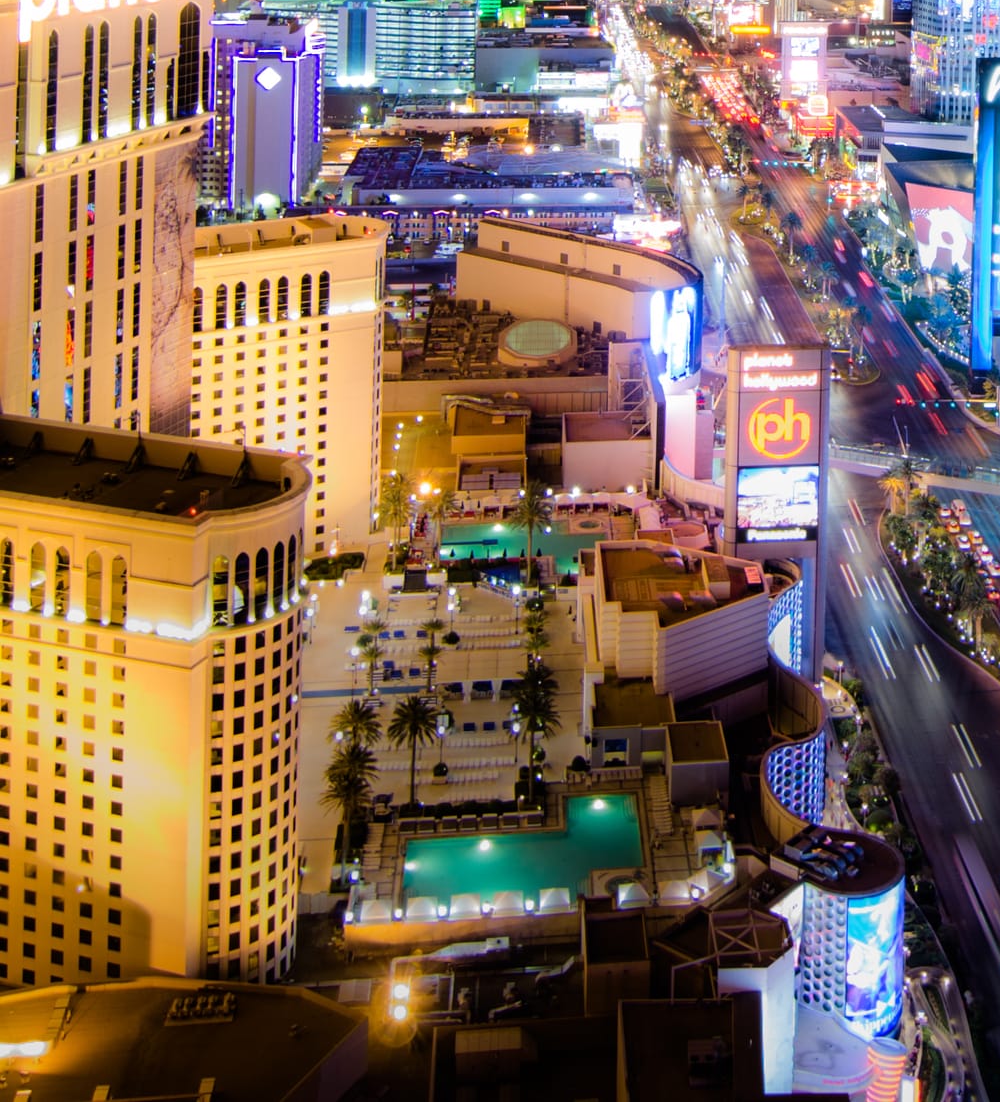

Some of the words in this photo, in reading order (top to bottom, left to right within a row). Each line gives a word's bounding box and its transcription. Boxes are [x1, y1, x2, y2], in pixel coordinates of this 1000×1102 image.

[743, 352, 793, 371] planet
[743, 371, 818, 391] hollywood
[756, 398, 811, 452] ph
